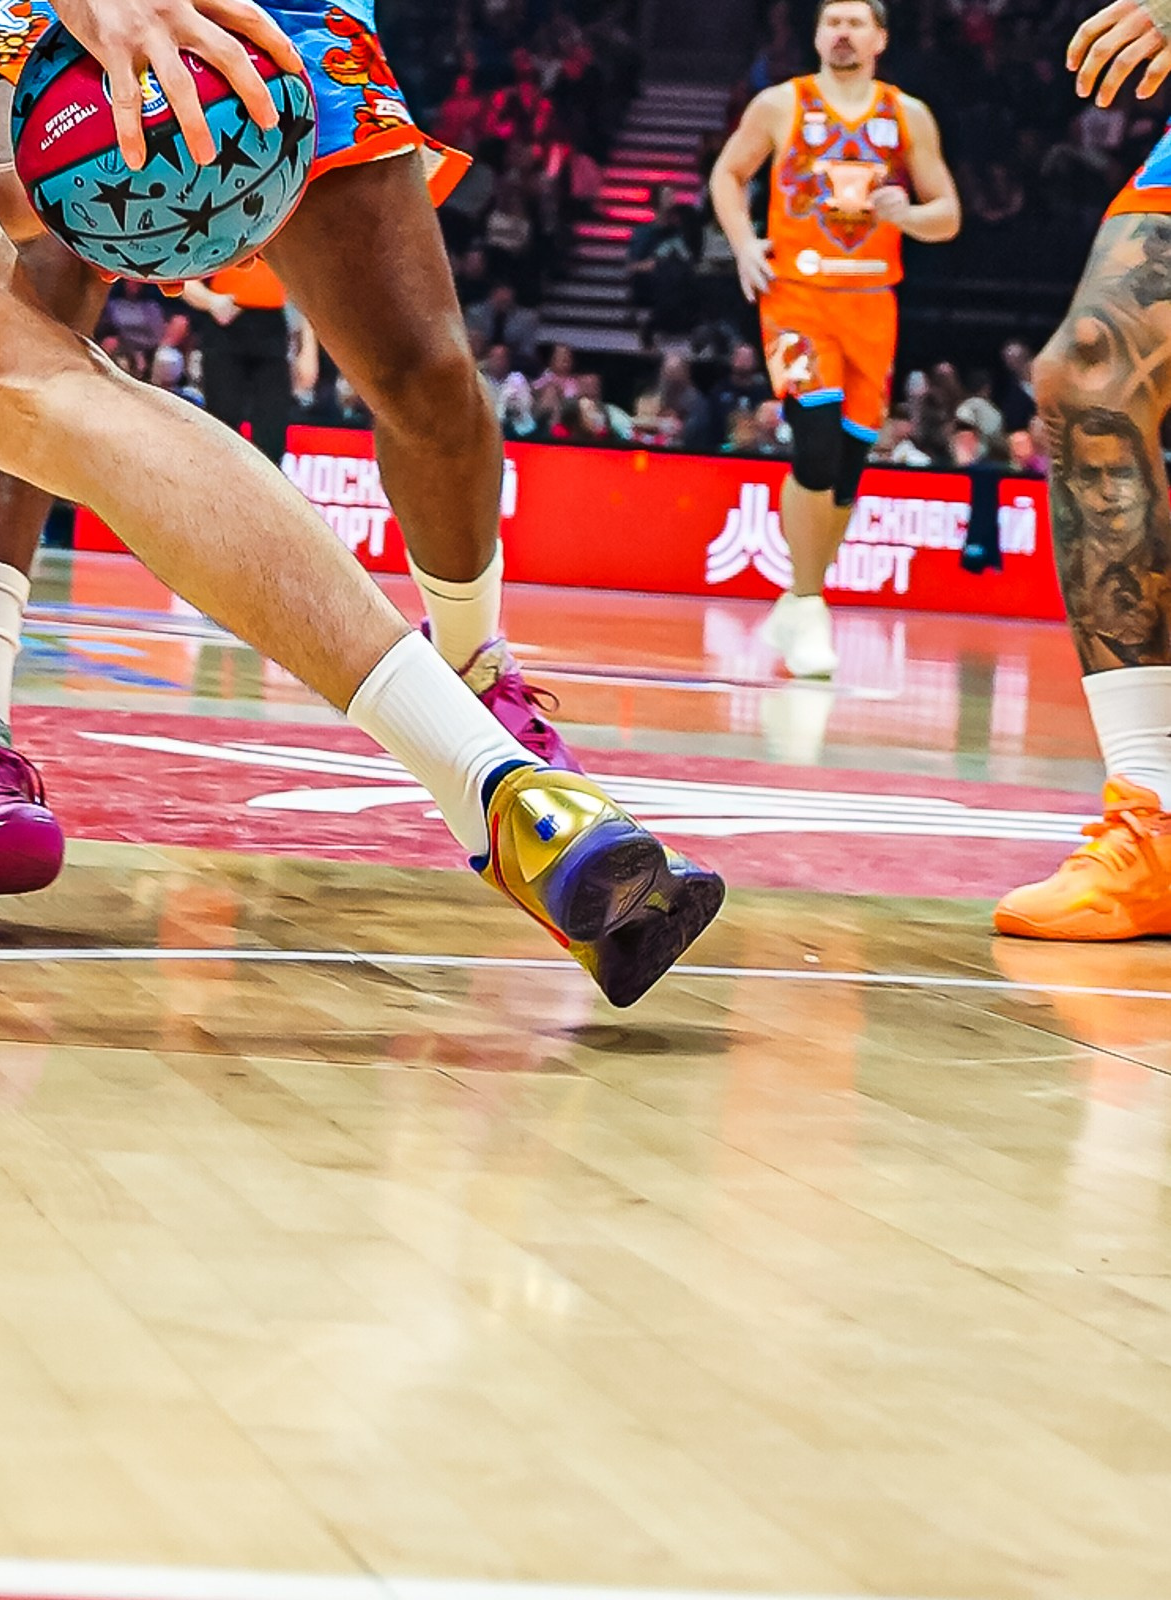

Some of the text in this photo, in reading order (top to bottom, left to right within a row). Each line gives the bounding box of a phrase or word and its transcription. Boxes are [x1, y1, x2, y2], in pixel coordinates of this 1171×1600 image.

[39, 103, 99, 151] ALL-STAR BALL
[44, 101, 82, 133] OFFICIAL
